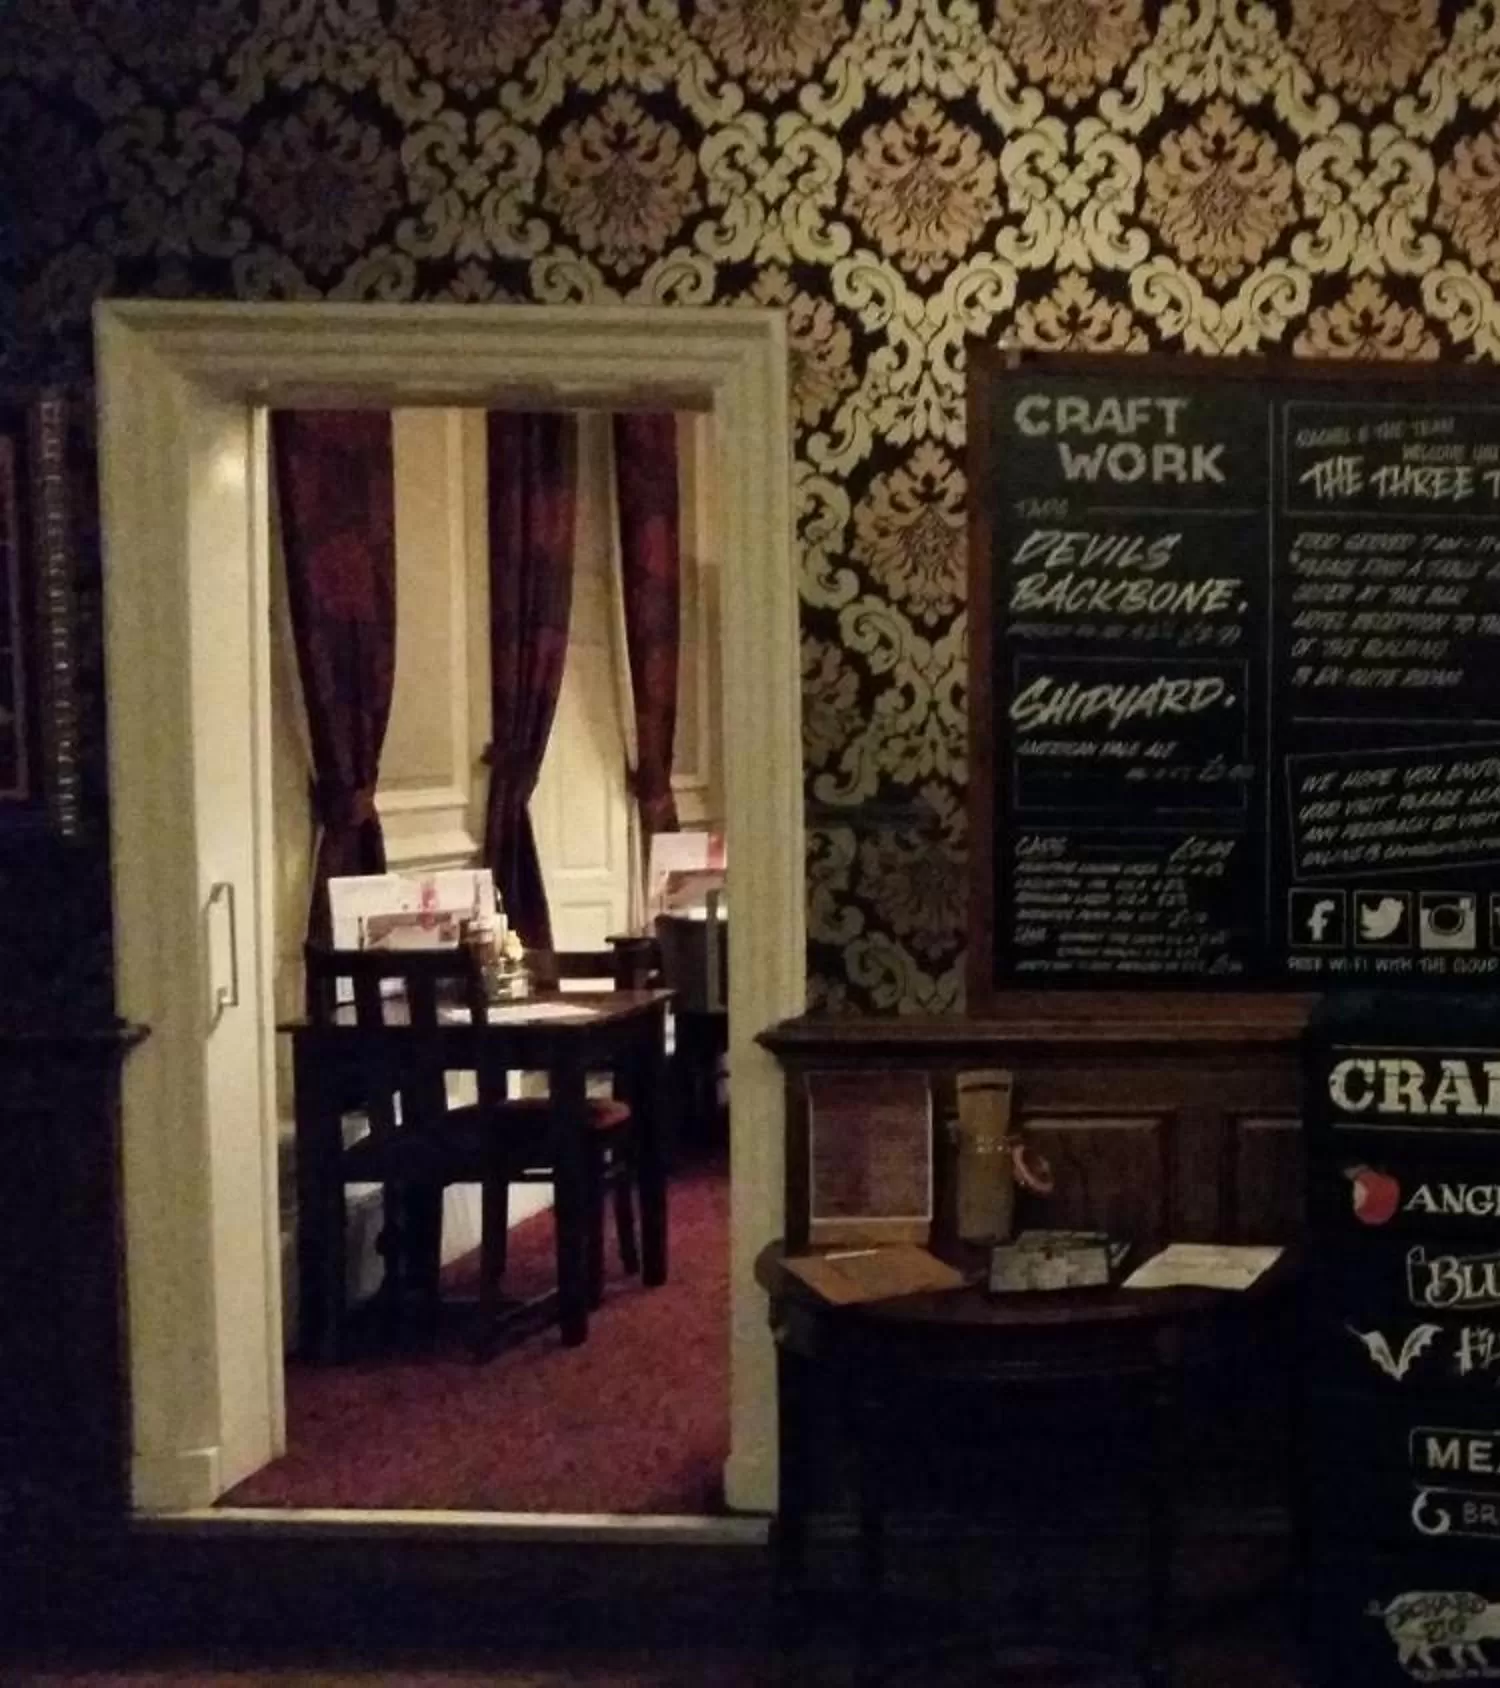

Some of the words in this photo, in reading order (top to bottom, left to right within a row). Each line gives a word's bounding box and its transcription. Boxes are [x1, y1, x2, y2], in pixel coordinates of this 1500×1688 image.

[1013, 394, 1189, 436] CRAFT
[1058, 442, 1226, 483] WORK
[1299, 454, 1365, 499] THE
[1369, 463, 1476, 502] THREE
[1011, 529, 1183, 571] DEVILS
